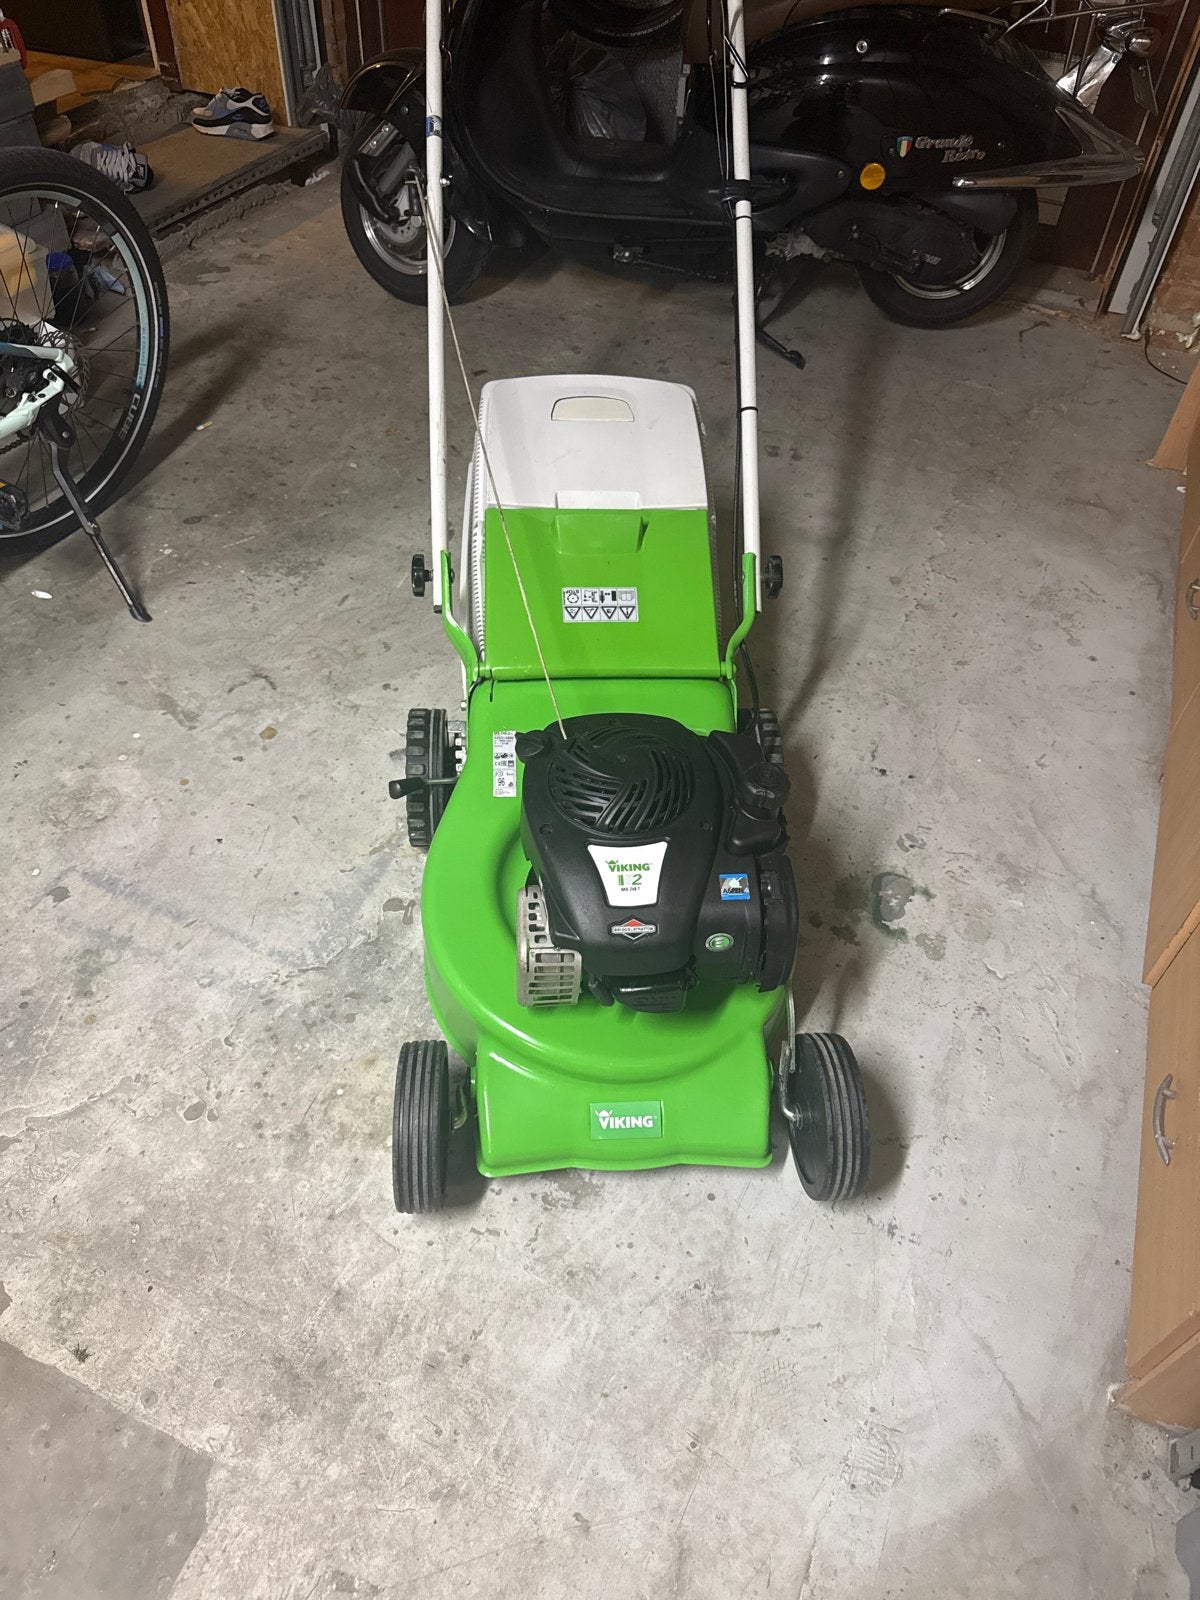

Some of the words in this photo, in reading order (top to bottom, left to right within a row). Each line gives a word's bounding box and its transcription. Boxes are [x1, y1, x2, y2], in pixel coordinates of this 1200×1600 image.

[915, 134, 974, 149] Grande
[118, 393, 141, 442] CUBE
[608, 863, 650, 872] VIKING
[598, 1115, 653, 1129] VIKING
